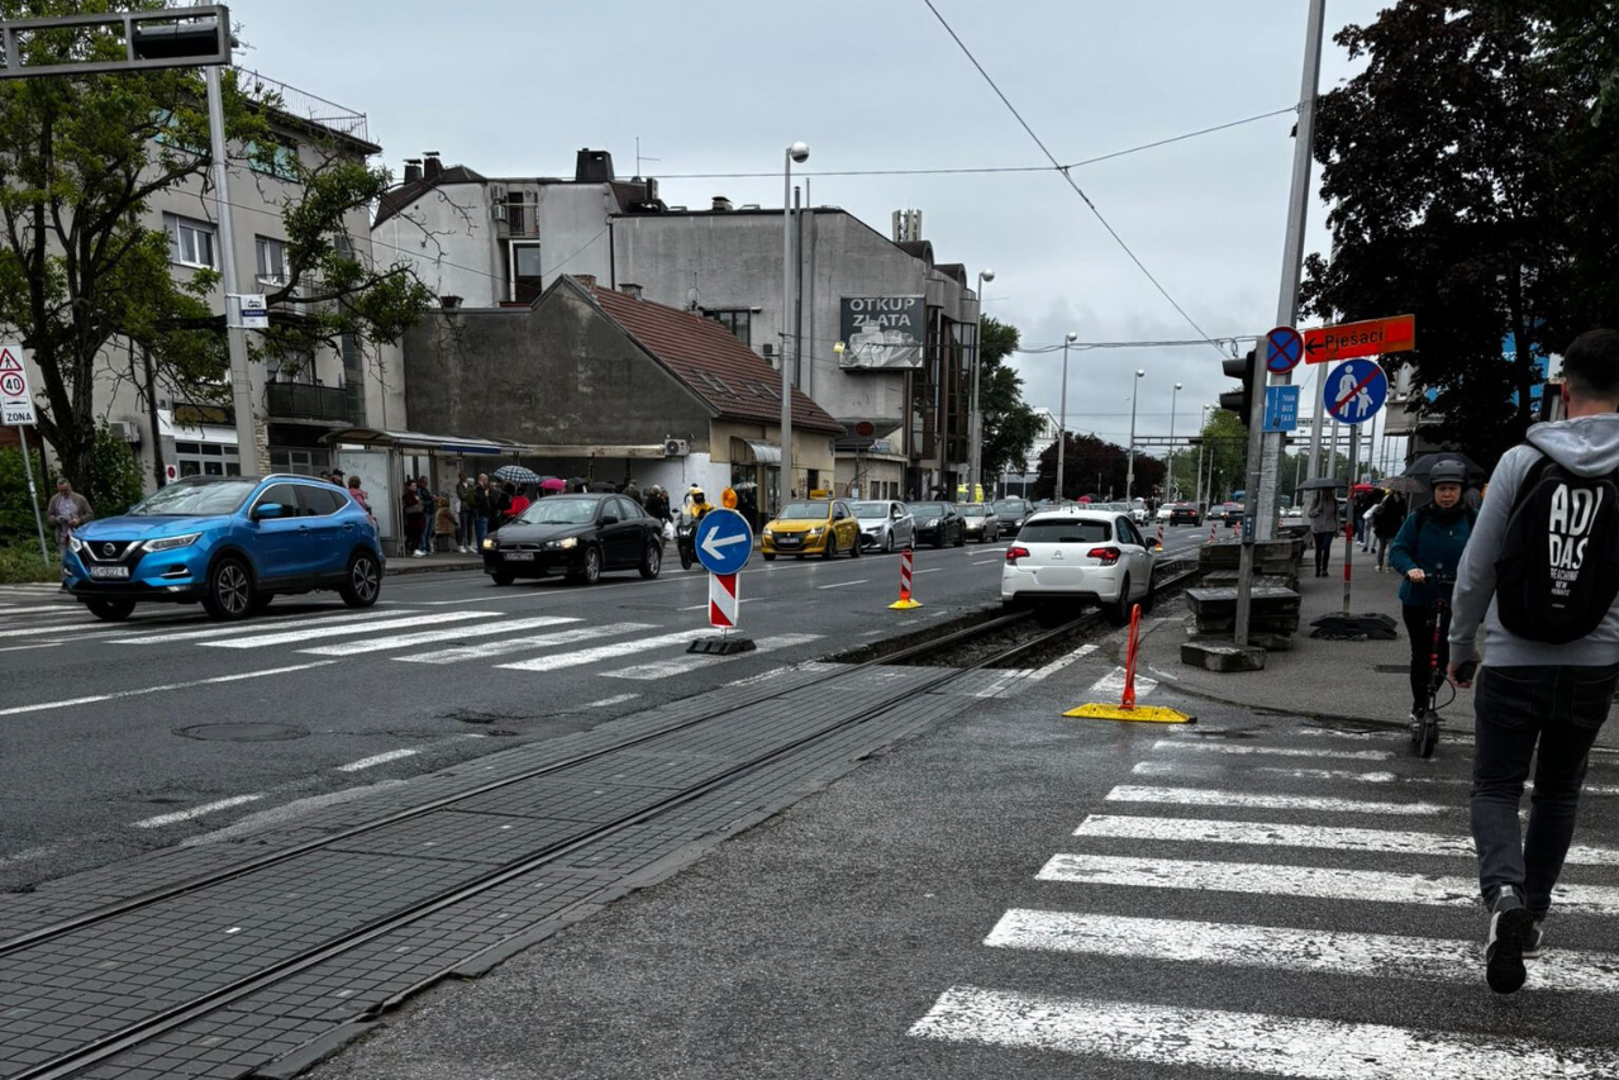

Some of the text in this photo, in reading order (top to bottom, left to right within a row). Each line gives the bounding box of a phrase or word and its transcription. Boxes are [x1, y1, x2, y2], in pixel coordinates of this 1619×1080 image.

[850, 298, 915, 311] OTKUP
[852, 314, 911, 326] ZLATA
[1324, 328, 1384, 351] Pješaci
[6, 378, 20, 391] 40
[6, 412, 32, 422] ZONA
[1549, 533, 1589, 569] DAS
